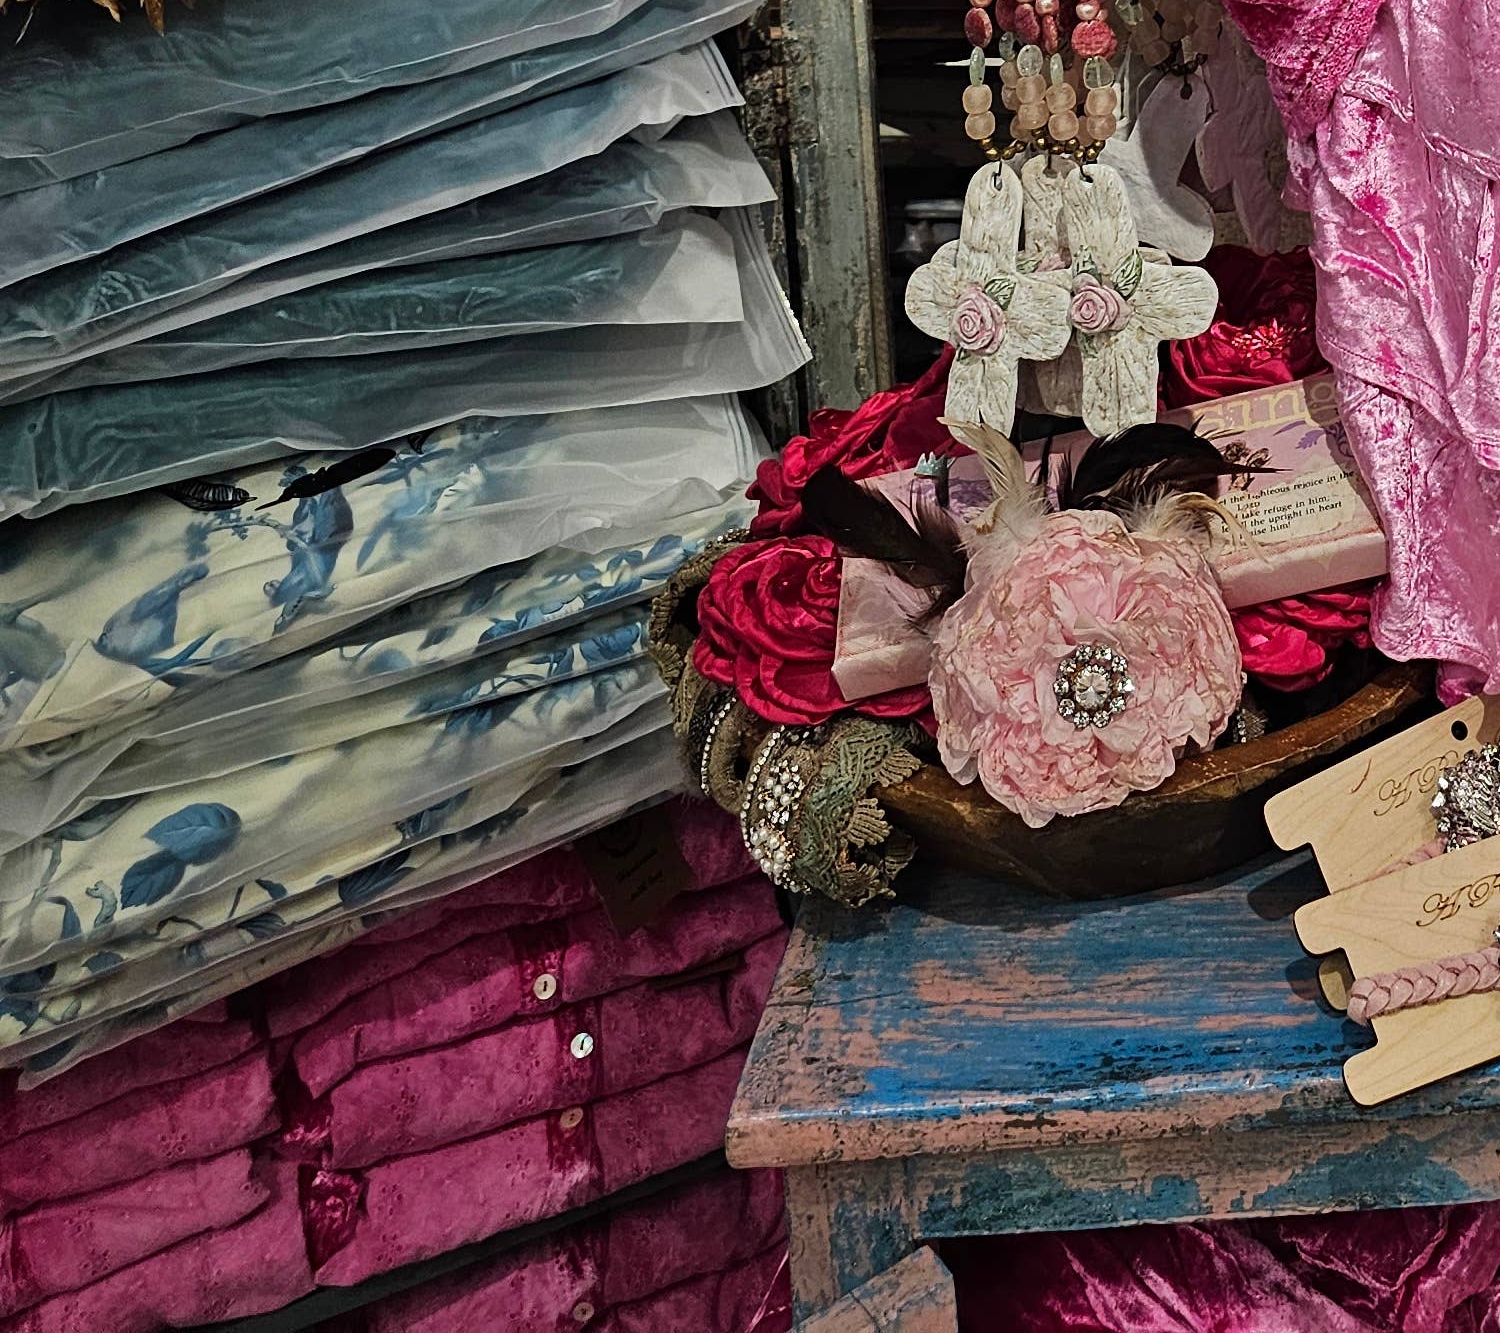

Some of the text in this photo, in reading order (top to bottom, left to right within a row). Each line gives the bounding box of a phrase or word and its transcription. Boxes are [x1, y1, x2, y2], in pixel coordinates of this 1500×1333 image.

[1230, 495, 1245, 504] the
[1293, 478, 1324, 490] rejoice
[1340, 471, 1354, 480] the
[1242, 510, 1260, 520] take
[1264, 504, 1292, 515] refuge
[1295, 501, 1305, 509] in
[1251, 518, 1265, 527] the
[1269, 510, 1302, 523] upright
[1306, 507, 1315, 515] in
[1319, 501, 1342, 512] heart
[1373, 768, 1421, 816] A
[1416, 884, 1472, 928] A
